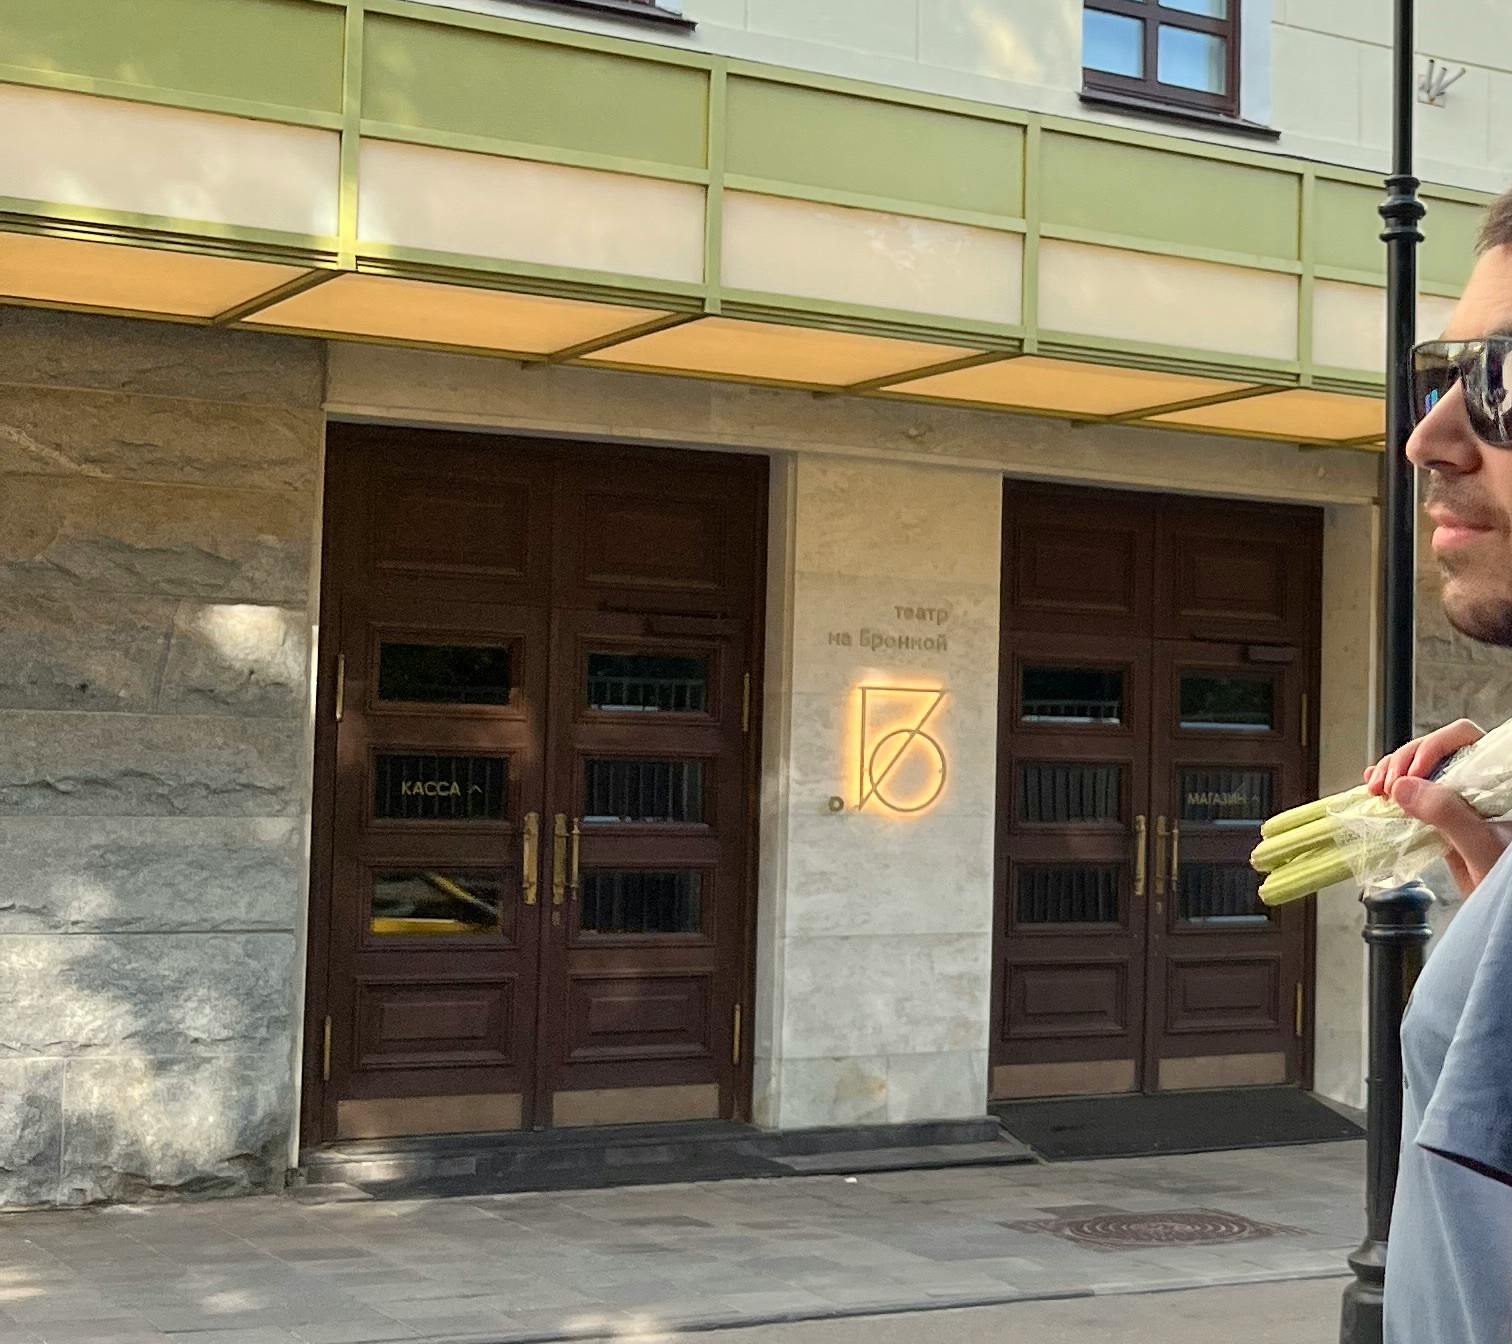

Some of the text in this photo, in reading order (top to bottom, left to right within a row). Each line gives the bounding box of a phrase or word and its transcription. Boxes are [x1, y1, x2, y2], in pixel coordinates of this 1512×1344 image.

[894, 605, 948, 626] театр
[828, 628, 948, 652] на Бронной
[401, 781, 461, 797] КАССА
[1187, 791, 1249, 806] МАГАЗИН
